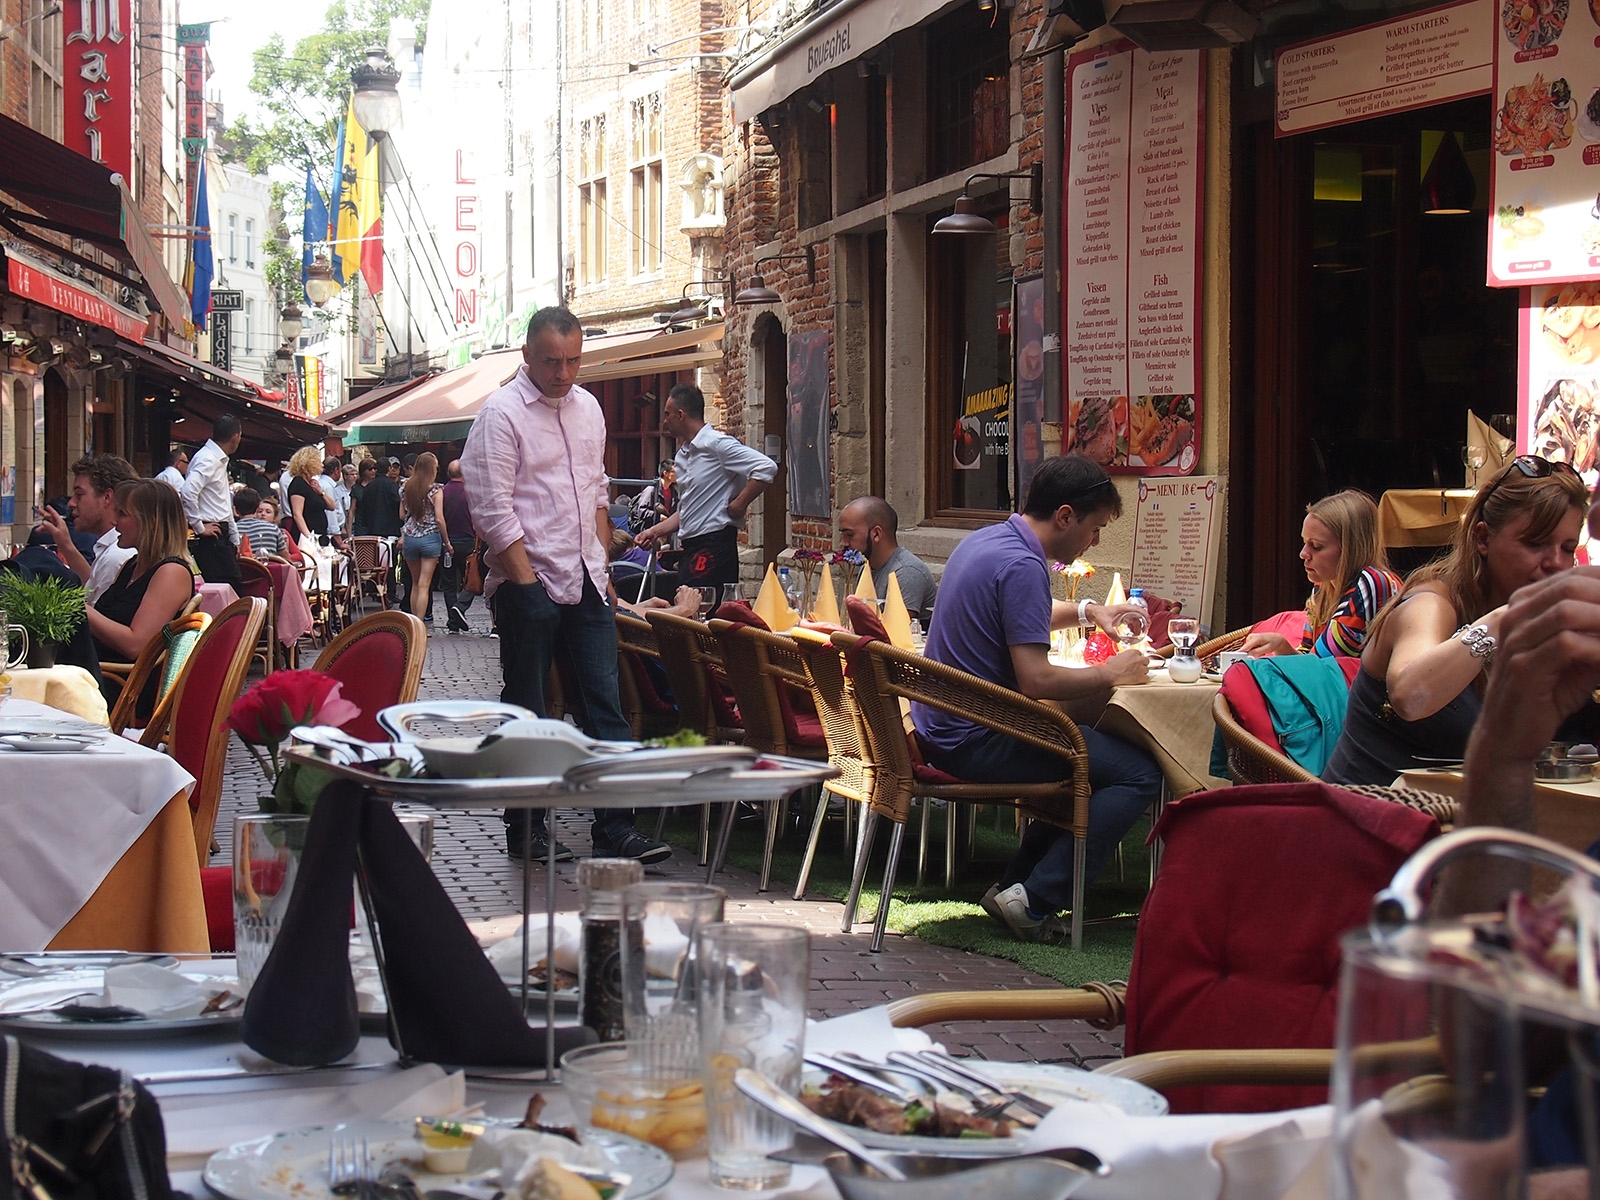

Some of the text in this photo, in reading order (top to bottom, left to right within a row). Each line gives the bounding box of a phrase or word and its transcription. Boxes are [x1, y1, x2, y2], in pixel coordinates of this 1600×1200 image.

[1386, 15, 1449, 38] WARM STARTERS
[1386, 43, 1407, 53] Scallops
[1408, 38, 1420, 46] with
[1283, 45, 1335, 65] COLD STARTERS
[1398, 48, 1425, 61] croquettes
[1312, 59, 1338, 70] mozzarella
[1386, 63, 1404, 72] Grilled
[1406, 58, 1426, 69] gambas
[1434, 52, 1450, 62] garlic
[1386, 59, 1464, 83] Burgundy snails garlic butter
[1294, 75, 1316, 85] carpaccio
[1283, 88, 1297, 97] Parma
[1337, 96, 1366, 108] Assortment
[1383, 89, 1394, 97] food
[1163, 101, 1168, 110] of
[1169, 99, 1179, 107] beef
[1345, 106, 1361, 115] Mixed
[1362, 102, 1373, 113] grill
[1381, 100, 1390, 108] fish
[1154, 151, 1160, 159] of
[1160, 149, 1170, 158] beef
[1160, 174, 1165, 182] of
[1167, 184, 1179, 193] duck
[1163, 198, 1168, 206] of
[1169, 196, 1181, 204] lamb
[1150, 211, 1163, 220] Lamb
[1163, 221, 1181, 229] chicken
[456, 149, 476, 323] LEON
[1160, 234, 1177, 242] chicken
[1140, 249, 1155, 257] Mixed
[1155, 247, 1165, 258] grill
[1090, 256, 1099, 266] grill
[1154, 274, 1168, 286] Fish
[1087, 282, 1107, 293] Vissen
[1144, 289, 1178, 299] Grilled salmon
[53, 285, 105, 320] RESTAURANT
[212, 295, 239, 306] AINT
[1169, 312, 1183, 320] fennel
[1138, 324, 1183, 336] Anglerfish with leek
[1130, 340, 1143, 348] Fillets
[1150, 338, 1158, 346] sole
[1159, 337, 1180, 345] Cardinal
[1181, 336, 1192, 345] style
[1152, 350, 1161, 358] sole
[1162, 349, 1178, 357] Ostend
[1179, 349, 1190, 358] style
[1148, 374, 1164, 382] Grilled
[1156, 484, 1178, 496] MENU
[695, 556, 707, 571] B
